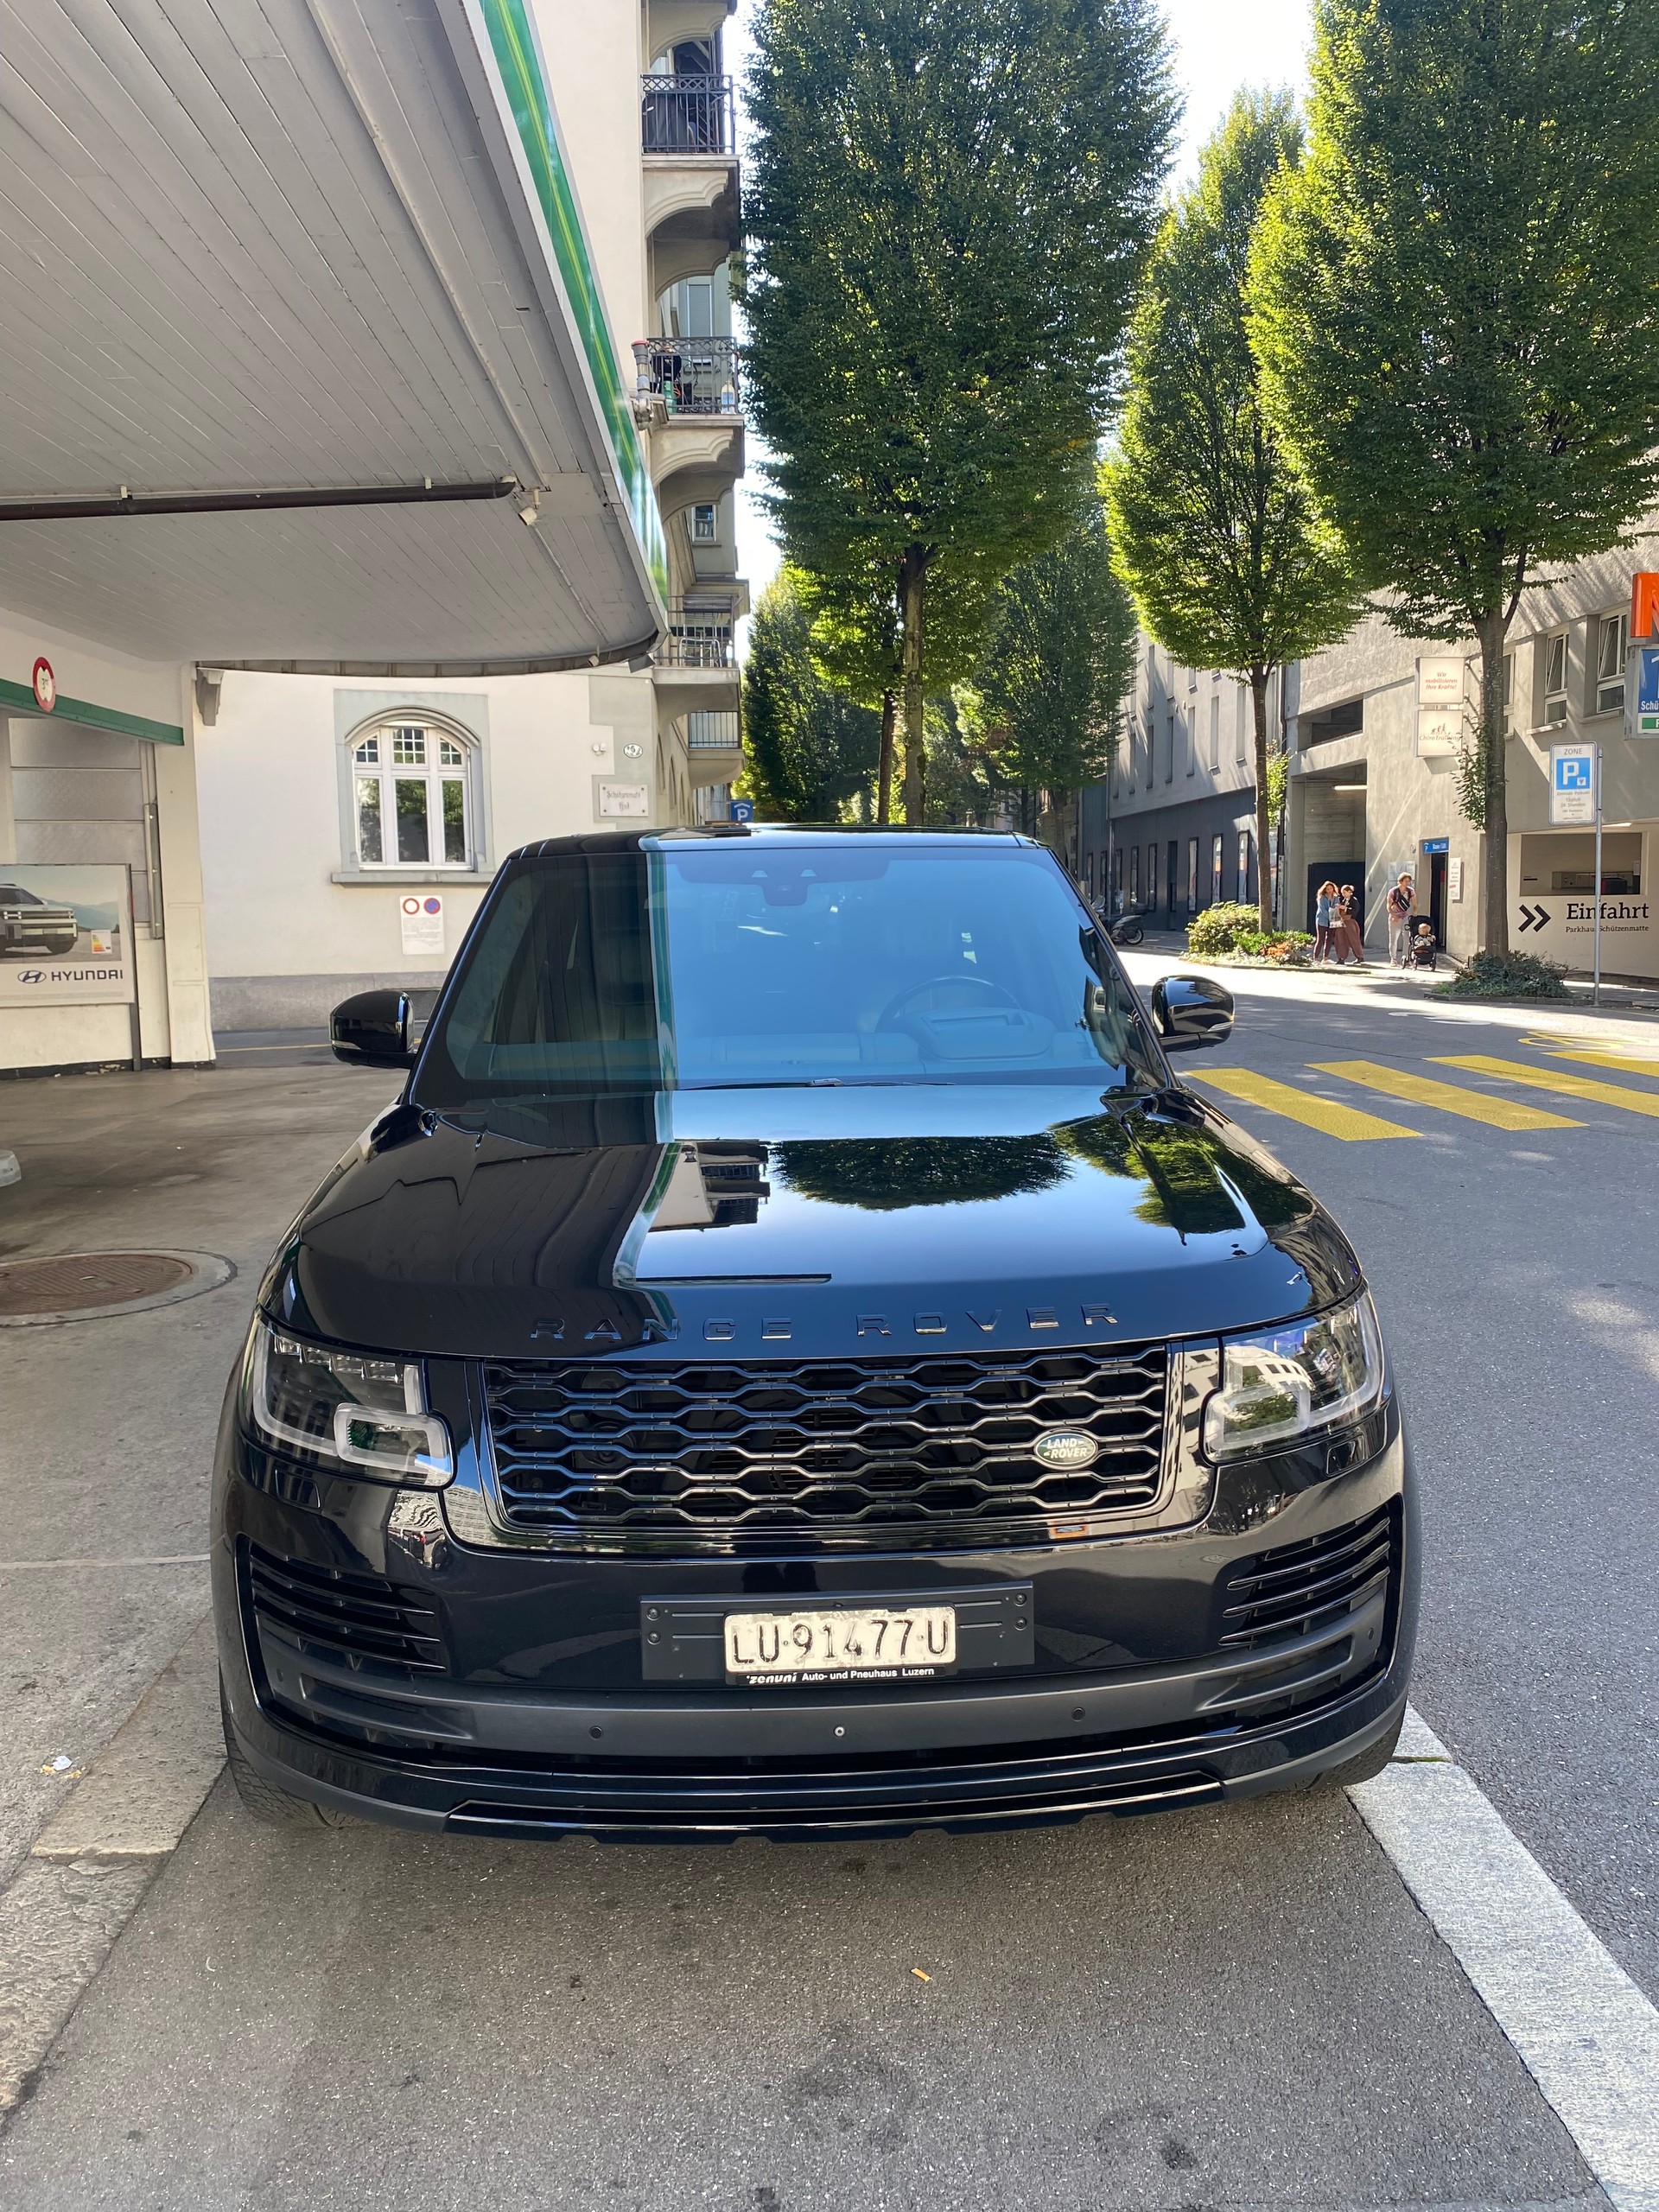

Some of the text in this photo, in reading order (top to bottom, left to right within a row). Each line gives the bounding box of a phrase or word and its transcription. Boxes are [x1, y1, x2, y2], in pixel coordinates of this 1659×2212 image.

[1562, 761, 1580, 785] P
[737, 809, 748, 821] P
[1567, 902, 1649, 920] Einfahrt
[52, 969, 123, 982] HYUNDAI
[531, 1302, 1118, 1339] RANGE ROVER
[1046, 1439, 1077, 1448] LAND
[1051, 1447, 1088, 1459] ROVER
[802, 1671, 828, 1681] Auto-
[830, 1671, 849, 1680] und
[850, 1669, 898, 1679] Pneuhaus
[902, 1668, 934, 1677] Luzern
